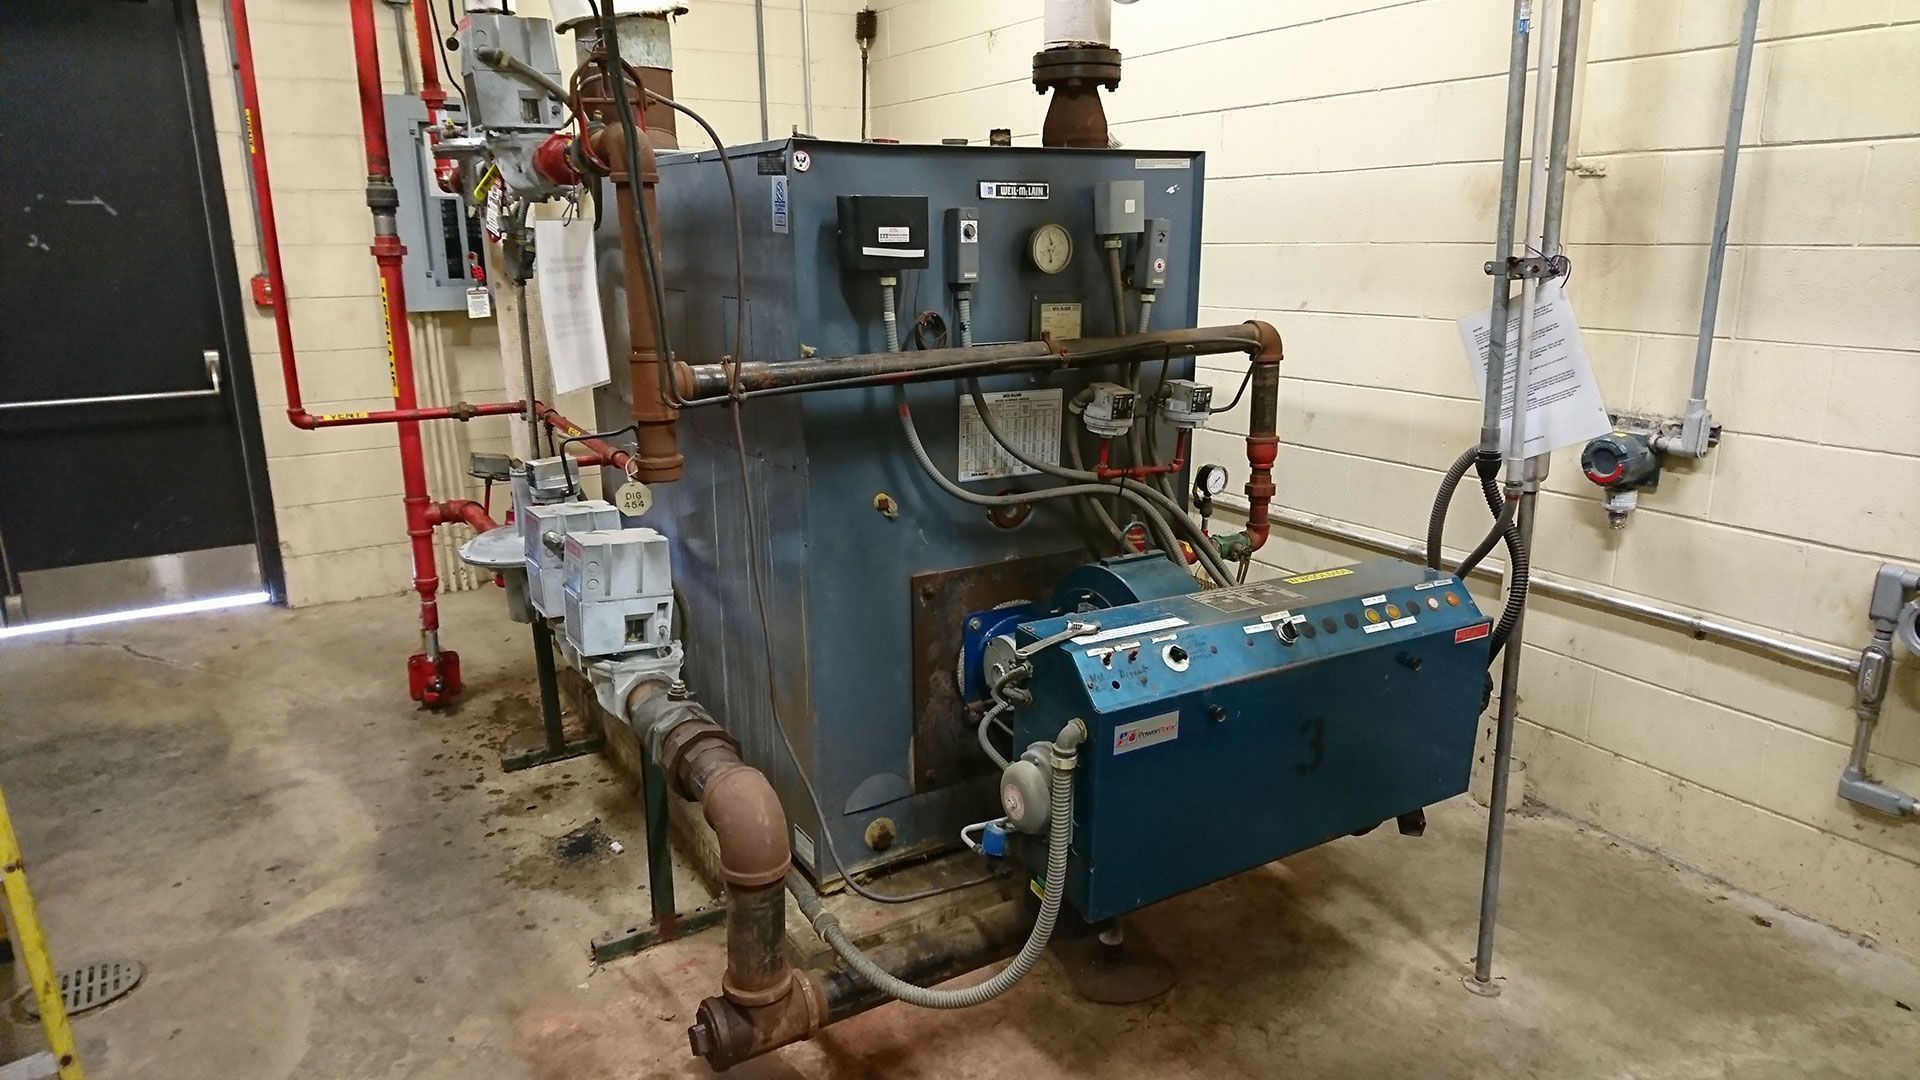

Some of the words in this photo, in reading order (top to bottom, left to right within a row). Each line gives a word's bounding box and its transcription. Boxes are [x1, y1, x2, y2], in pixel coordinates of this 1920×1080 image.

[625, 491, 642, 501] DIG
[624, 500, 645, 509] 454
[1296, 717, 1325, 777] 3
